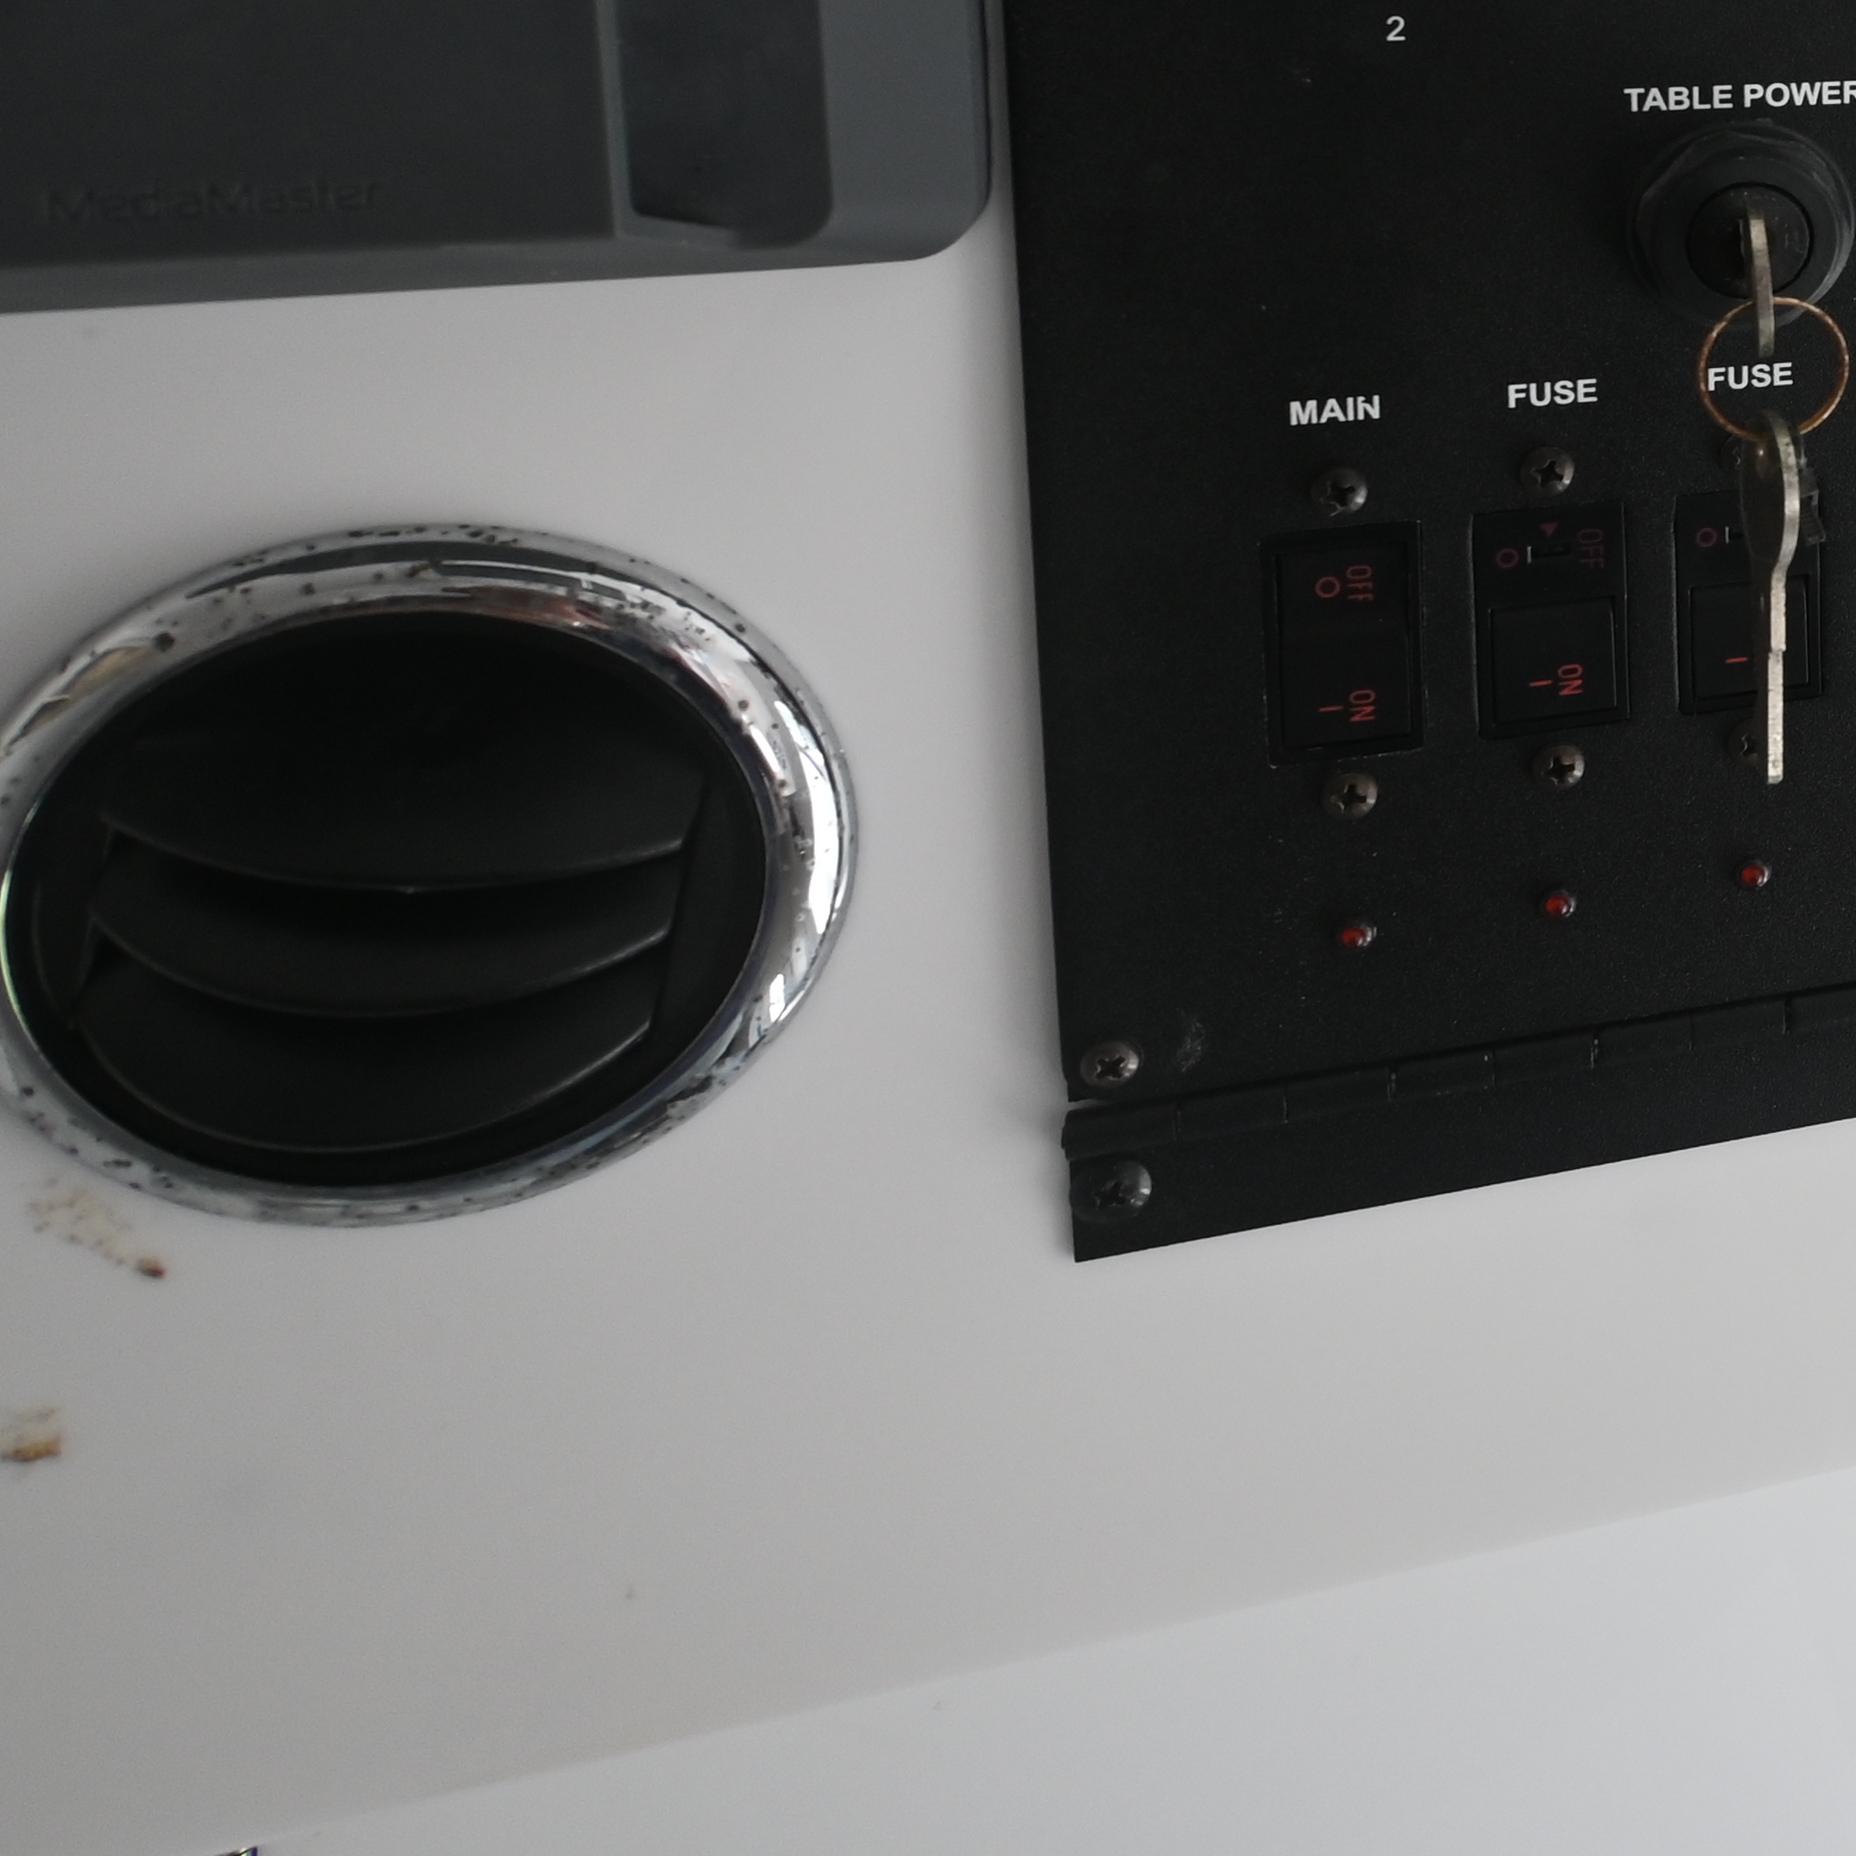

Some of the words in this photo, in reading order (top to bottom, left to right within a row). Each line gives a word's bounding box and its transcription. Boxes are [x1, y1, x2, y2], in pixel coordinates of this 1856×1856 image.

[1387, 16, 1405, 41] 2
[1624, 85, 1733, 112] TABLE
[1708, 362, 1793, 391] FUSE
[1508, 379, 1598, 408] FUSE
[1290, 395, 1380, 425] MAIN
[1344, 565, 1373, 603] OFF
[1557, 663, 1583, 697] ON
[1350, 689, 1376, 722] ON
